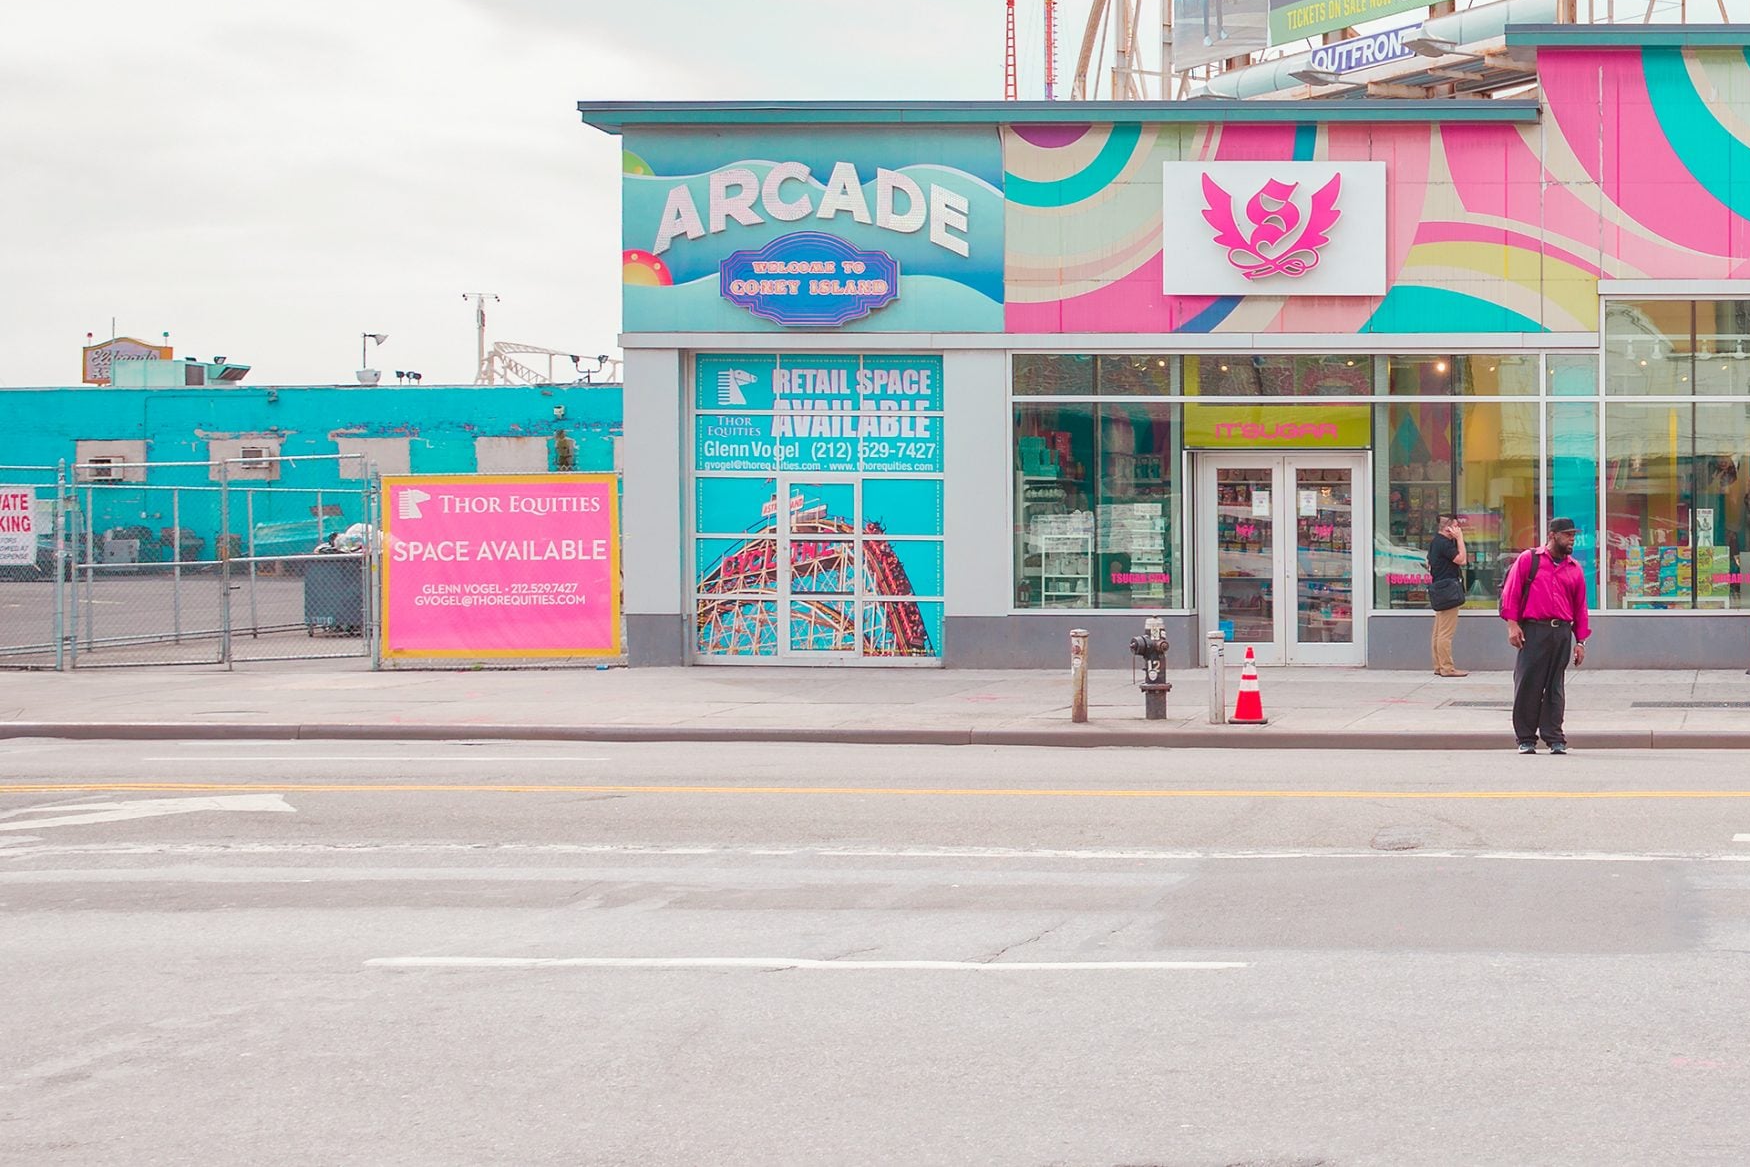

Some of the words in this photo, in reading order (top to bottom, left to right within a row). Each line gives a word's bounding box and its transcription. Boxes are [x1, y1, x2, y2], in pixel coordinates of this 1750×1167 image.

[1287, 3, 1326, 30] TICKETS
[652, 160, 971, 259] ARCADE
[752, 260, 836, 274] WELCOME
[842, 260, 866, 274] TO
[729, 279, 801, 296] CONEY
[809, 278, 889, 296] ISLAND
[772, 368, 851, 395] RETAIL
[856, 368, 932, 395] SPACE
[716, 415, 752, 426] THOR
[771, 398, 931, 438] AVAILABLE
[707, 426, 761, 438] EQUITIES
[704, 440, 749, 457] Glenn
[751, 441, 800, 461] Vogel
[811, 442, 852, 461] (212)
[857, 441, 936, 459] 529-7427
[438, 494, 502, 514] THOR
[509, 495, 601, 516] EQUITIES
[393, 540, 470, 562] SPACE
[476, 539, 607, 562] AVAILABLE
[422, 584, 462, 595] GLENN
[464, 584, 502, 595] VOGEL
[511, 583, 578, 594] 212.529.7427
[415, 594, 586, 606] GVOGEL@THOREQUITIES.COM
[1147, 660, 1161, 673] 12
